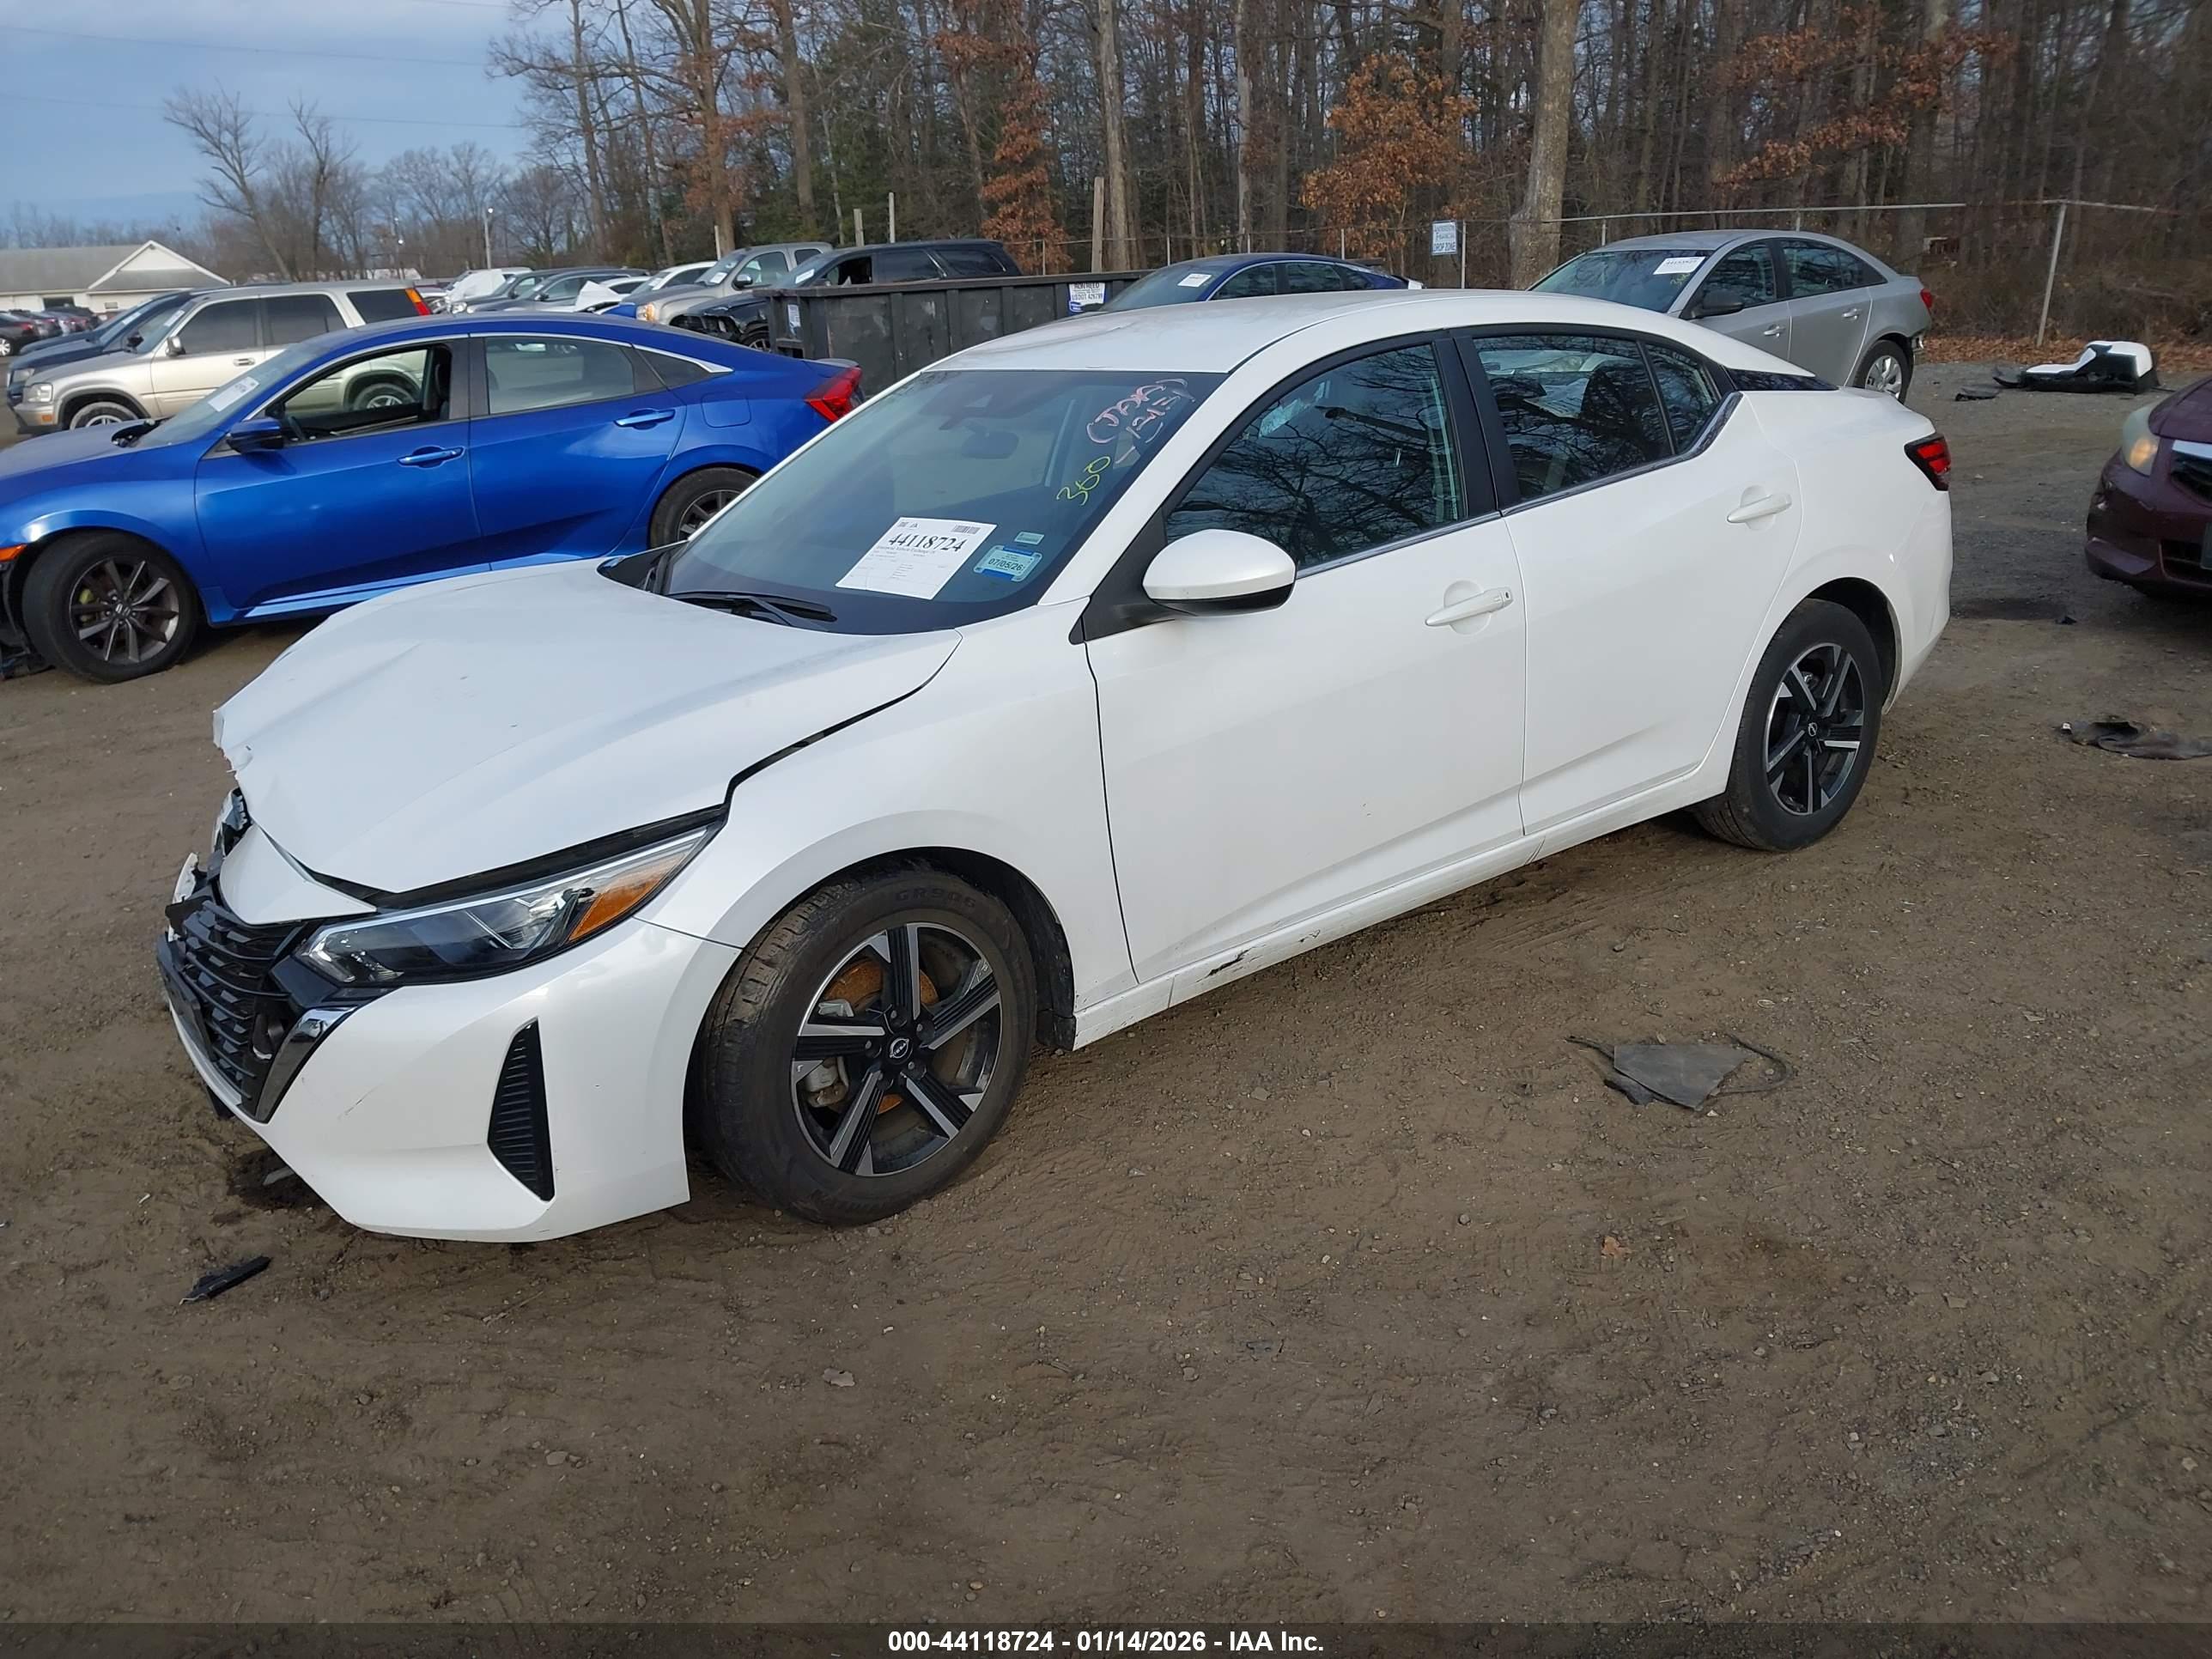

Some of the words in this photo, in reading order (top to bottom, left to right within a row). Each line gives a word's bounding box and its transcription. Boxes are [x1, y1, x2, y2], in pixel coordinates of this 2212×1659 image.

[1056, 456, 1111, 506] 360
[889, 532, 968, 552] 44118724
[988, 558, 1023, 571] 07/05/26
